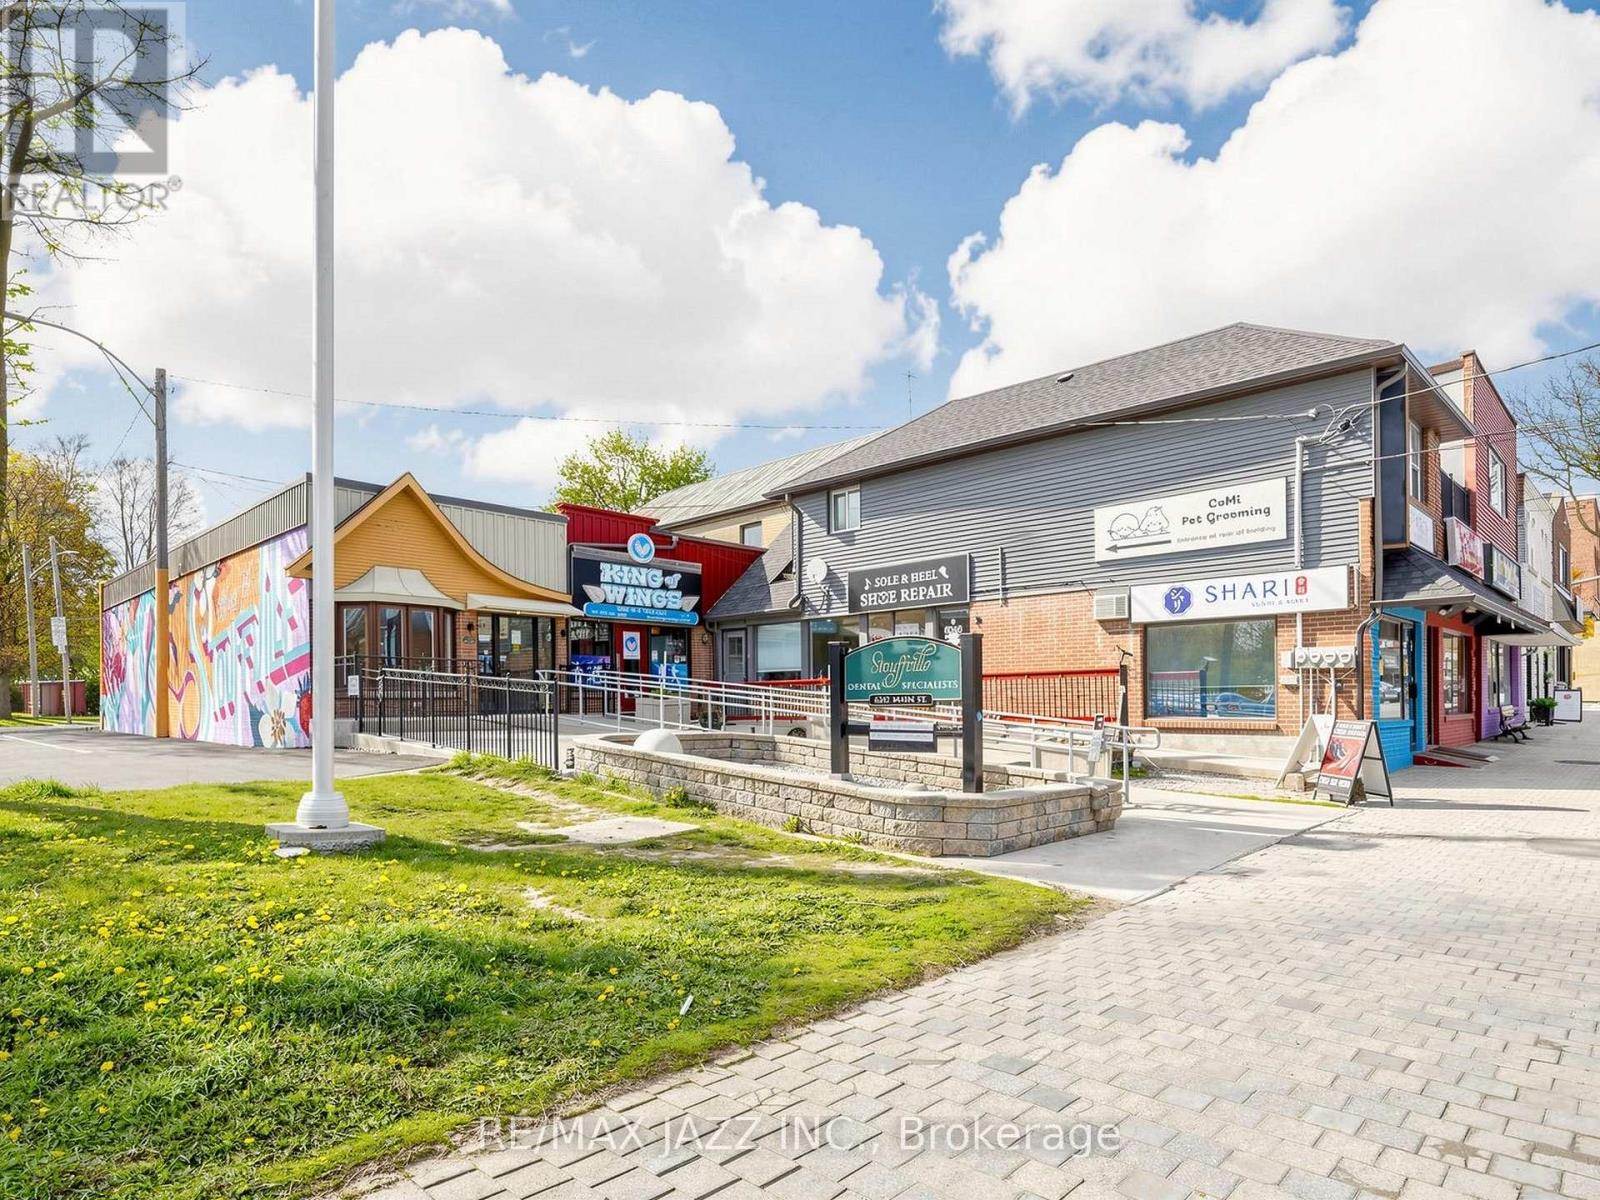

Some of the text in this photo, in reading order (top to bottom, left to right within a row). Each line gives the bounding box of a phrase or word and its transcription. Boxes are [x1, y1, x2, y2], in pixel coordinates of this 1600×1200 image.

[1208, 494, 1241, 509] CoMi
[1182, 505, 1271, 526] Pet Grooming
[1177, 533, 1207, 544] Entrance
[1246, 525, 1276, 536] building
[600, 562, 663, 588] KING
[874, 569, 938, 587] SOLE & HEEL
[601, 584, 682, 610] WINGS
[860, 584, 953, 607] SHOE REPAIR
[1205, 578, 1288, 603] SHARI
[871, 643, 937, 689] Stouffville
[848, 680, 959, 691] DENTAL SPECIALISTS
[892, 695, 915, 704] MAIN
